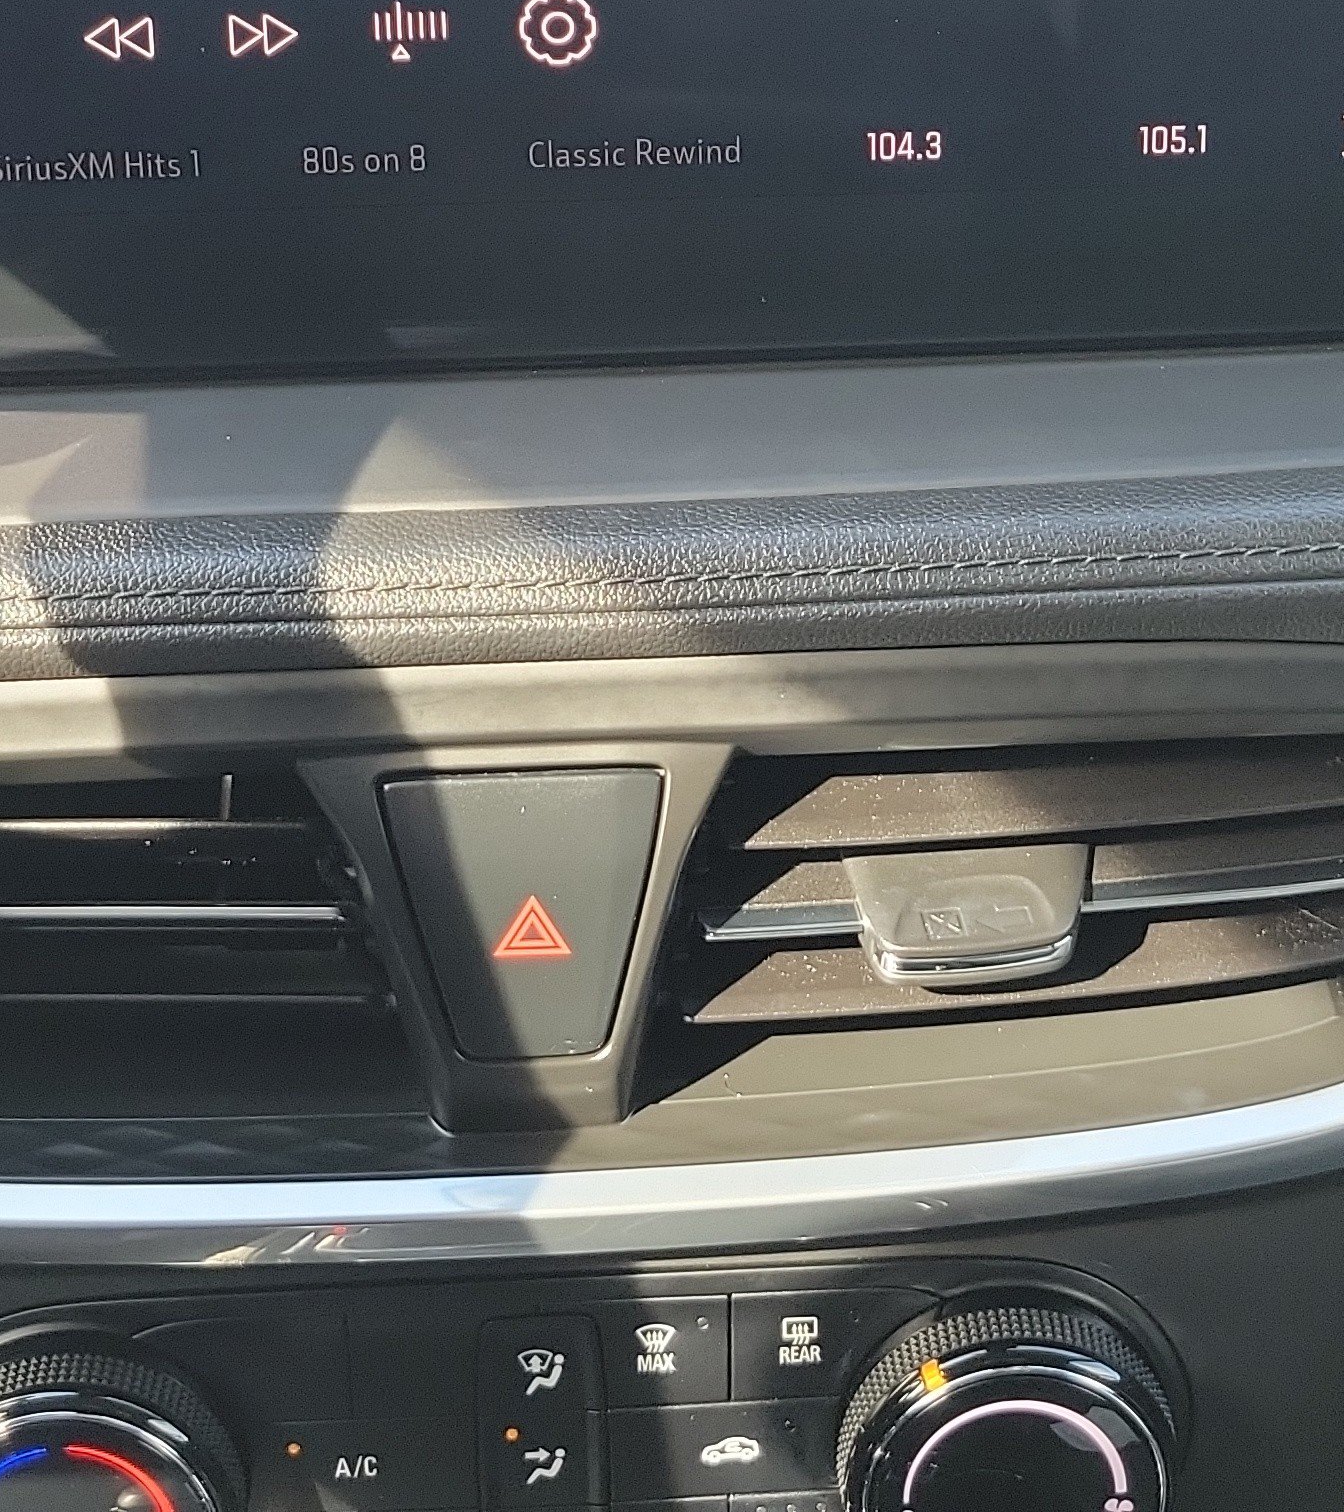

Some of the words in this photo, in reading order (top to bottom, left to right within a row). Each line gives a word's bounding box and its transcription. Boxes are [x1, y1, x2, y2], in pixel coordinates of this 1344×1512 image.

[528, 138, 627, 169] Classic
[635, 135, 741, 167] Rewind
[866, 130, 943, 162] 104.3
[1138, 123, 1208, 156] 105.1
[123, 150, 182, 180] Hits
[189, 148, 201, 178] 1
[302, 145, 356, 175] 80s
[363, 152, 400, 174] on
[408, 143, 427, 173] 8
[636, 1353, 677, 1374] MAX
[778, 1345, 822, 1366] REAR
[334, 1455, 378, 1479] A/C
